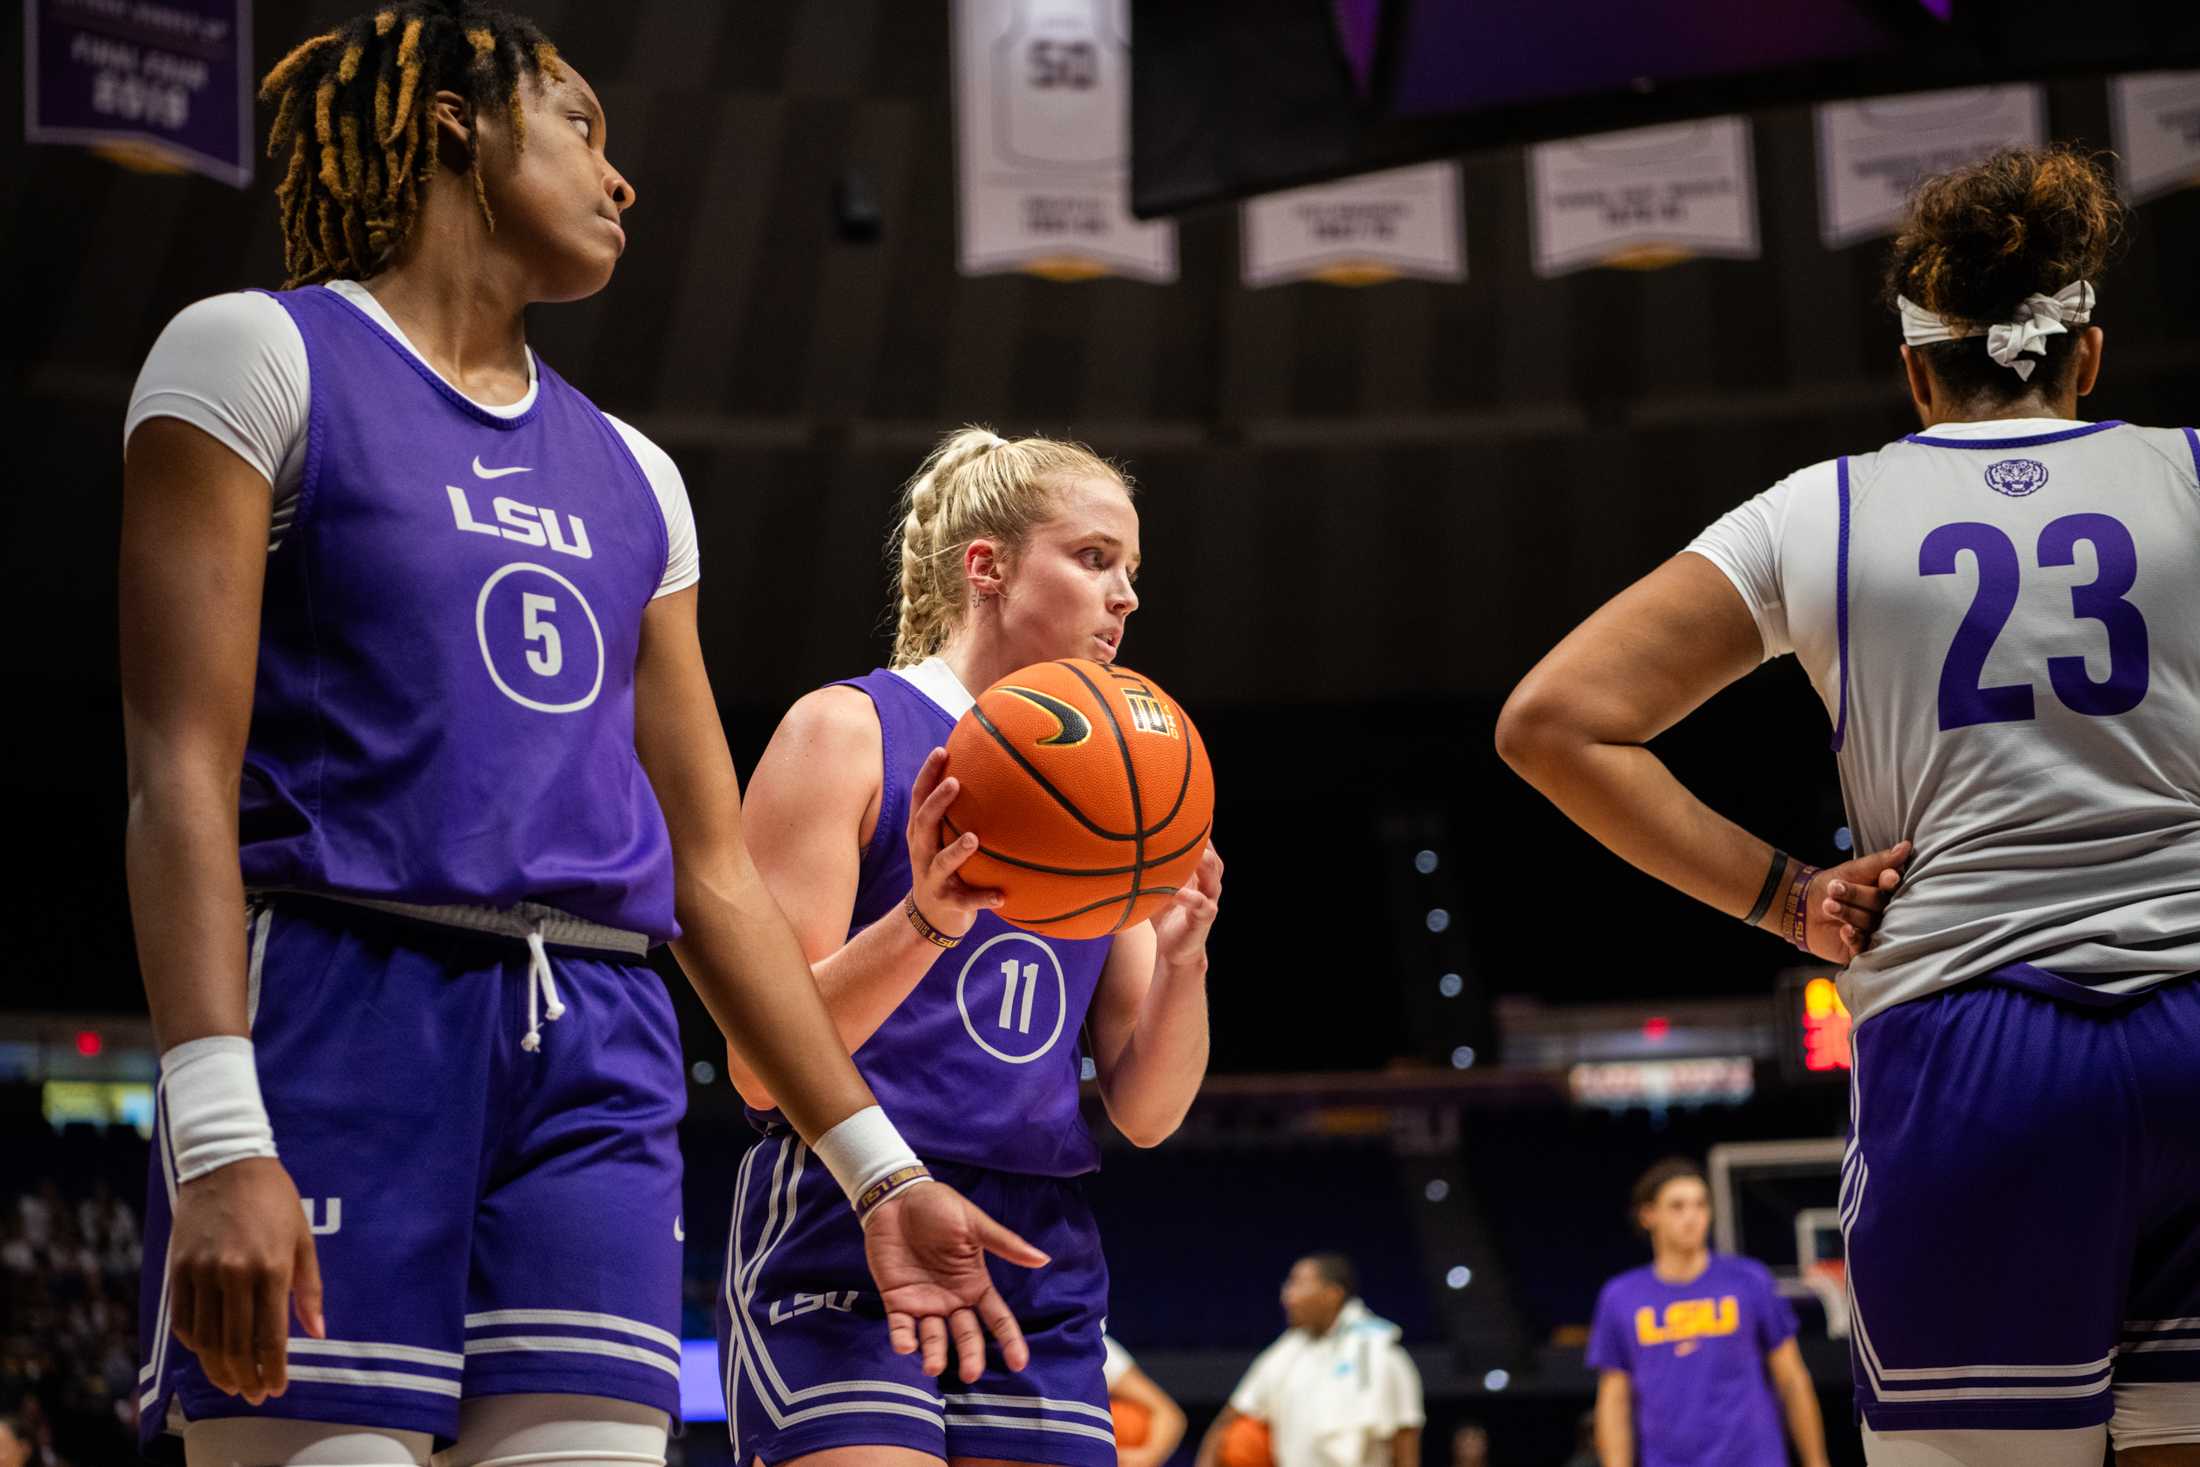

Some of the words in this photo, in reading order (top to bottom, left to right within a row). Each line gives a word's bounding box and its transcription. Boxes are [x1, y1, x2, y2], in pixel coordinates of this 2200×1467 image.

[446, 485, 593, 559] LSU
[523, 592, 563, 677] 5
[1919, 513, 2149, 731] 23
[929, 931, 961, 949] LSU
[998, 959, 1039, 1034] 11
[769, 1290, 859, 1326] LSU
[1635, 1295, 1740, 1346] LSU
